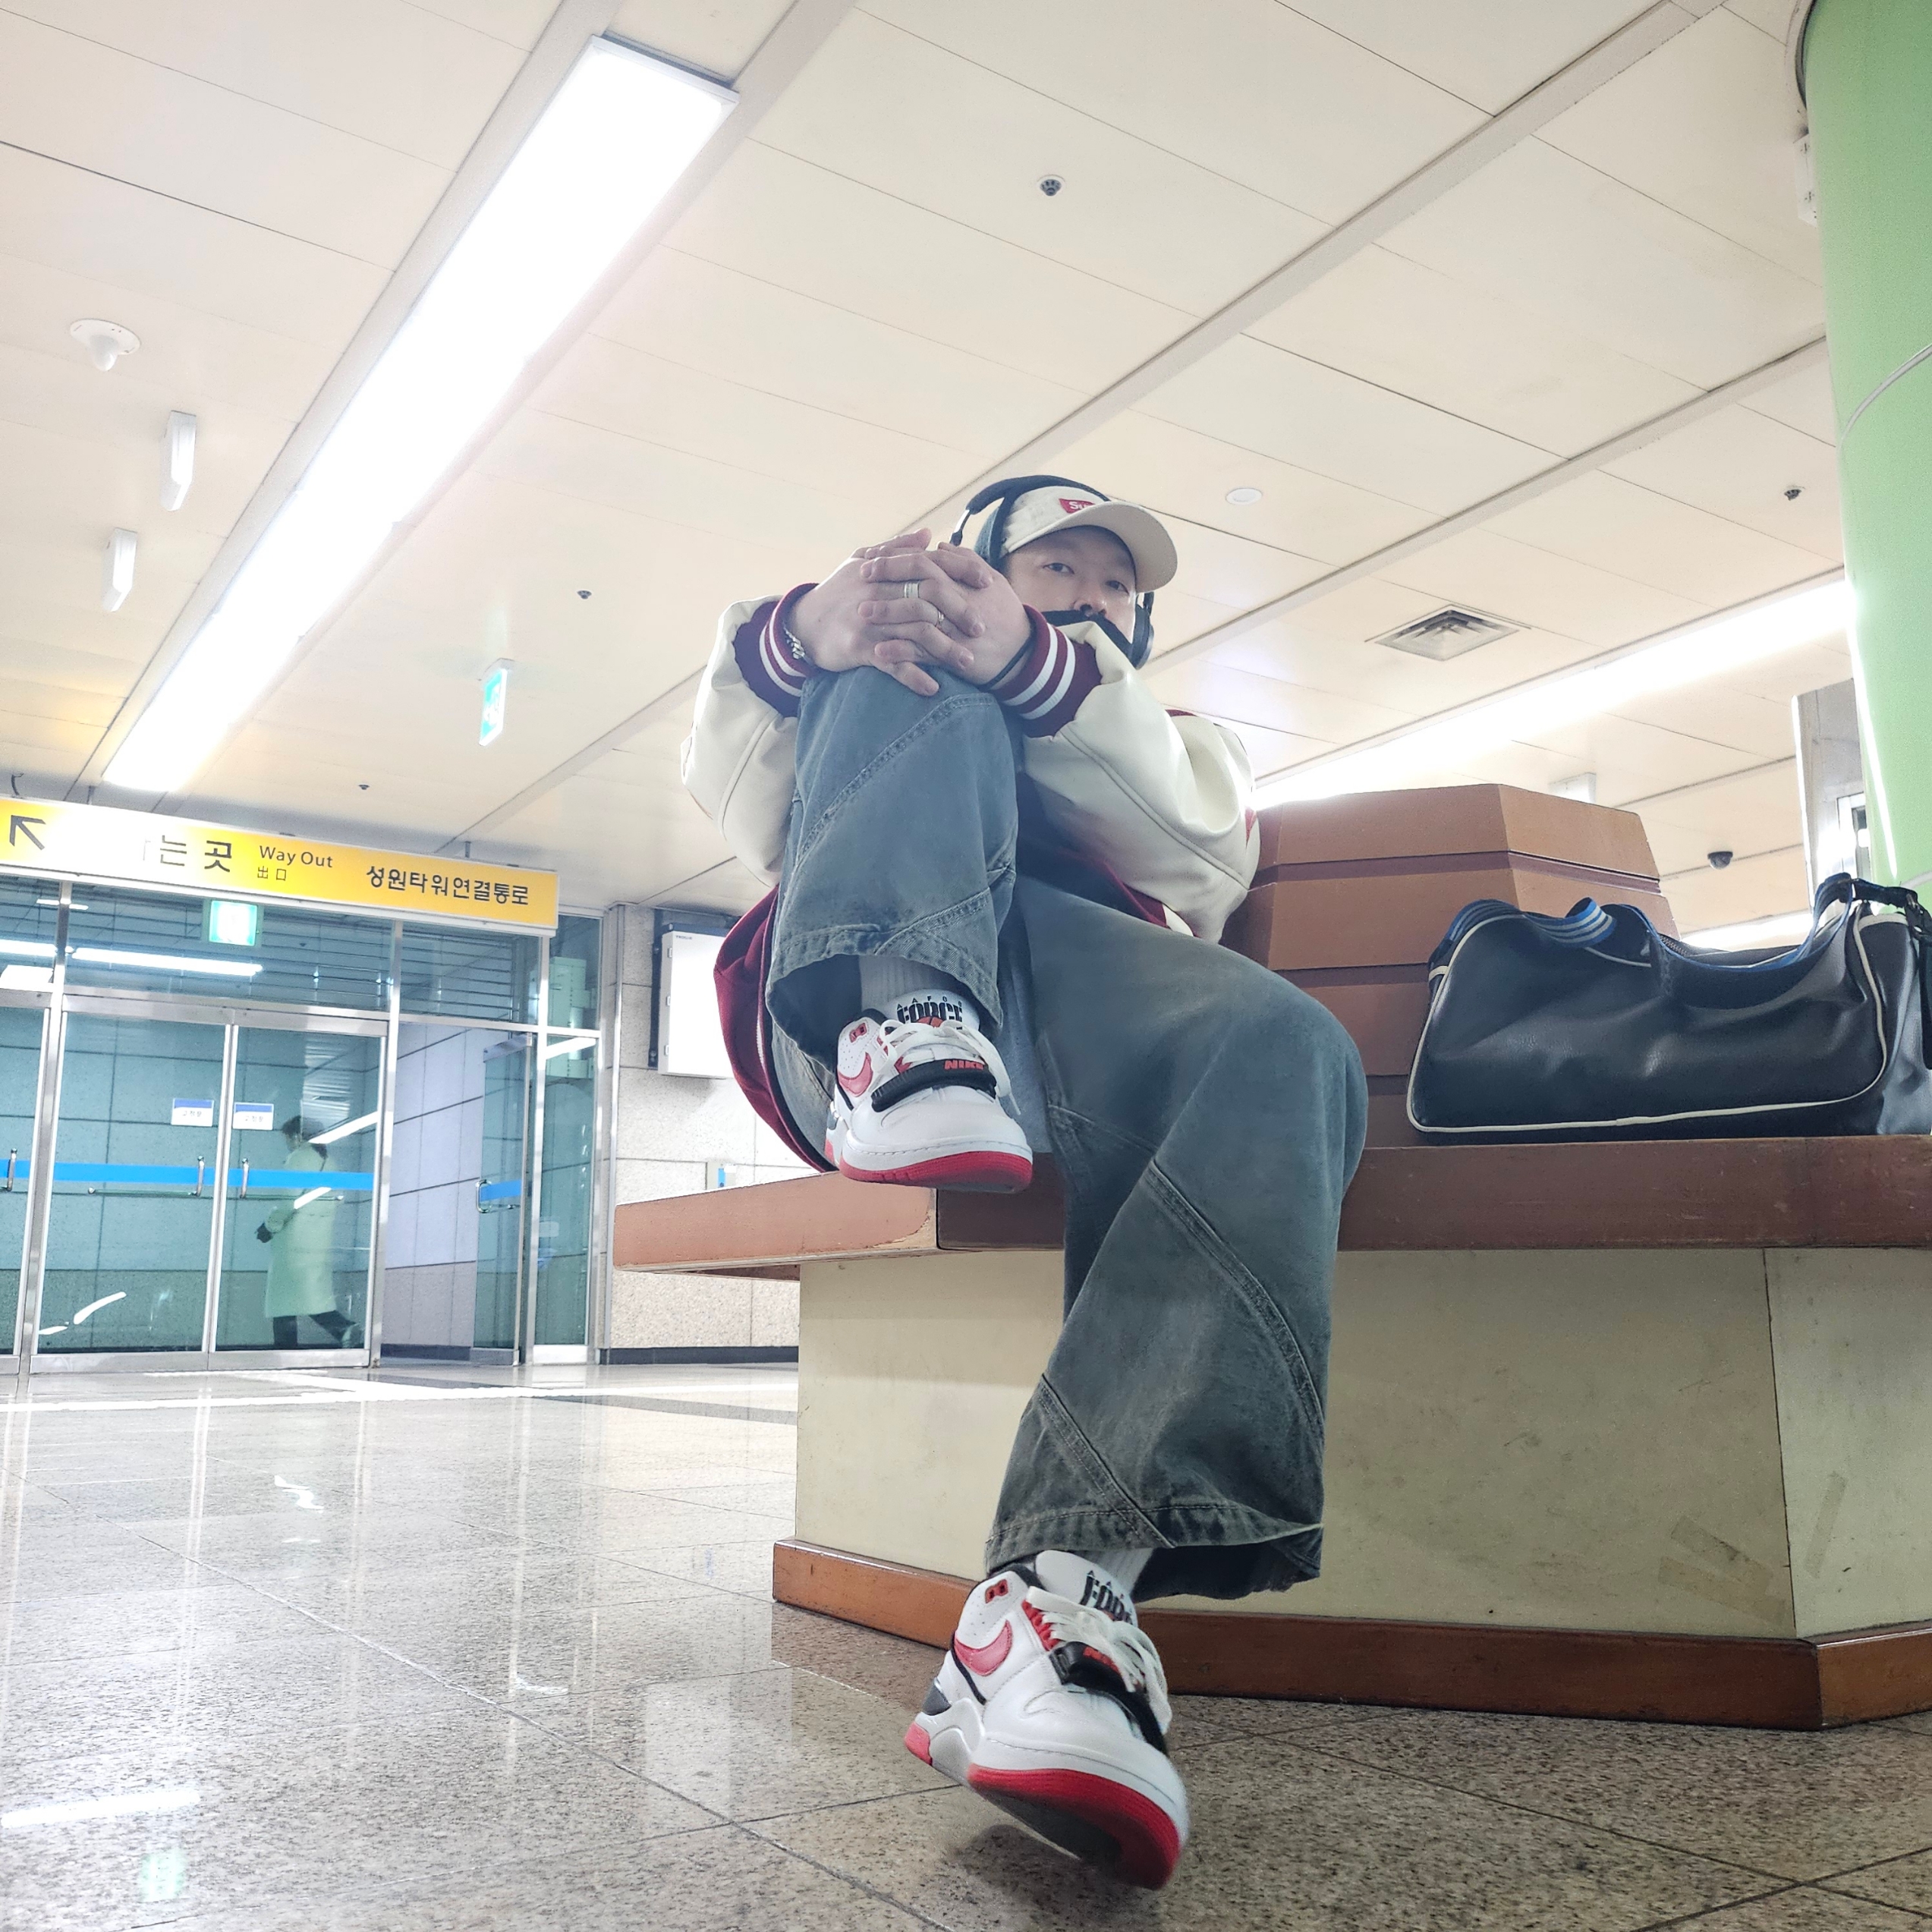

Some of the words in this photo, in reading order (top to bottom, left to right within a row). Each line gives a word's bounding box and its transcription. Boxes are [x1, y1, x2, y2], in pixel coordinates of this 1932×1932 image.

[204, 840, 232, 873] 곳
[260, 845, 296, 866] Way
[300, 851, 333, 868] Out
[257, 866, 287, 881] 出口
